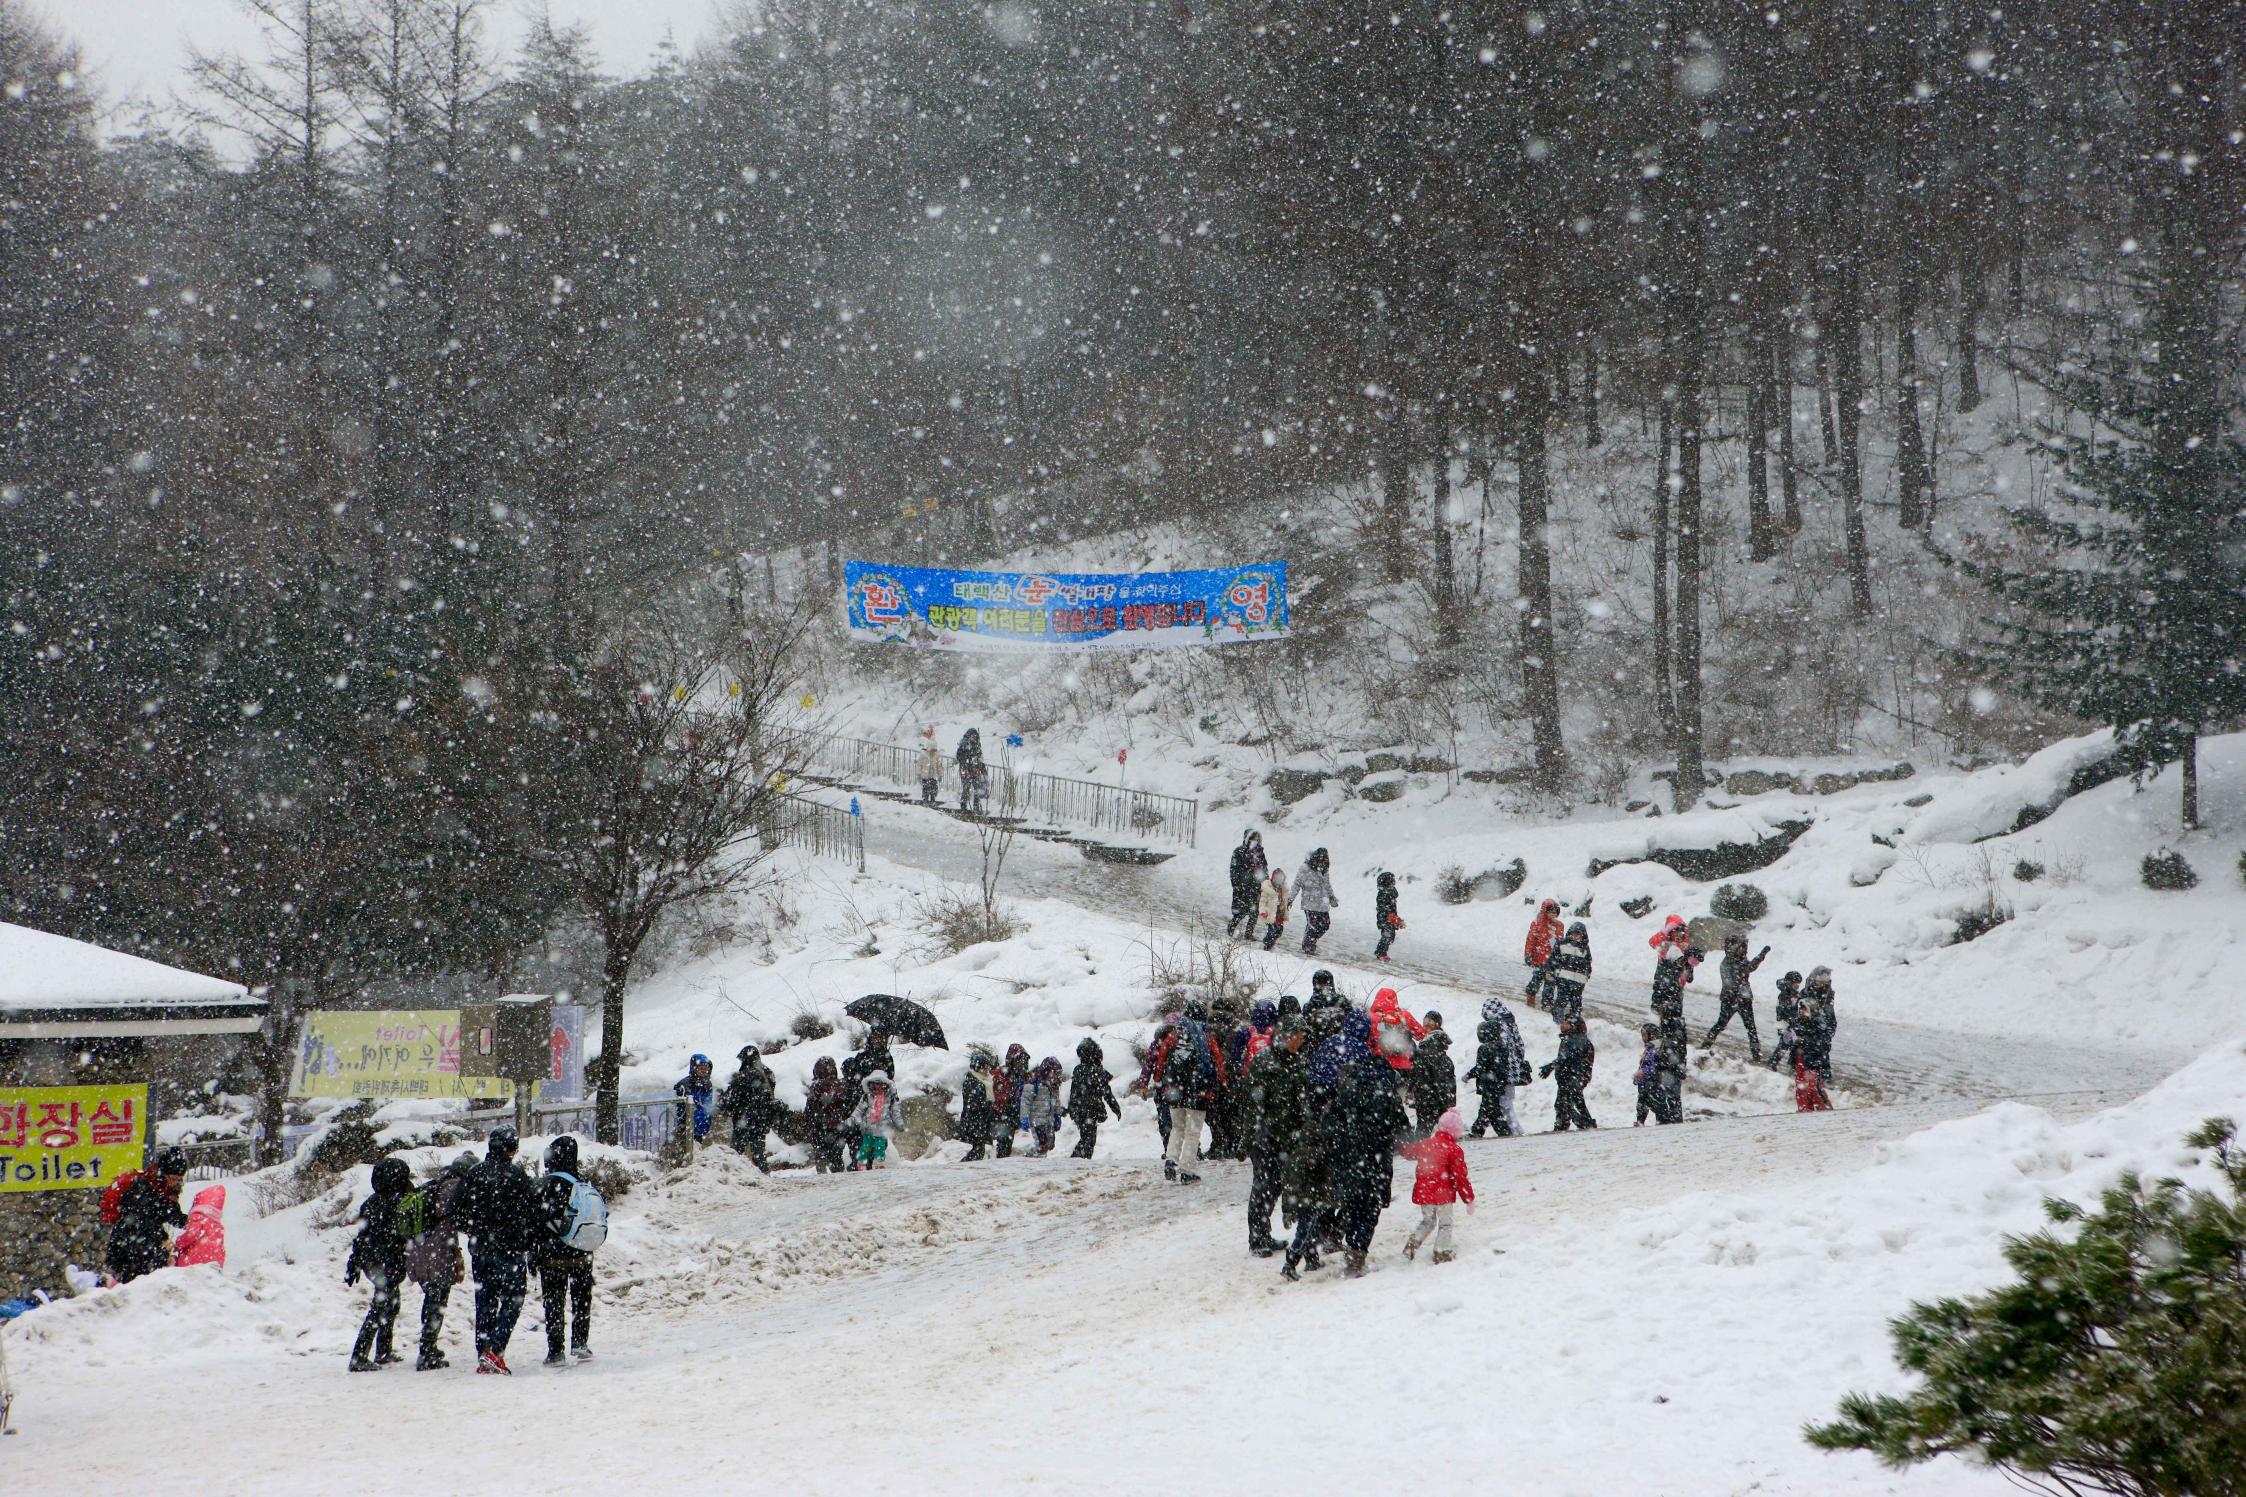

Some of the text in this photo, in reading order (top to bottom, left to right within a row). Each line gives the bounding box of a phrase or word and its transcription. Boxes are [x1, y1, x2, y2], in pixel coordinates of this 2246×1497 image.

[864, 583, 902, 624] 환
[954, 582, 1011, 602] 태백산
[1231, 583, 1269, 621] 영
[927, 604, 978, 632] 관광객
[983, 607, 1047, 633] 여러분을
[1122, 600, 1206, 631] 환영합니다
[0, 1099, 133, 1149] 화장실
[0, 1154, 102, 1182] Toilet
